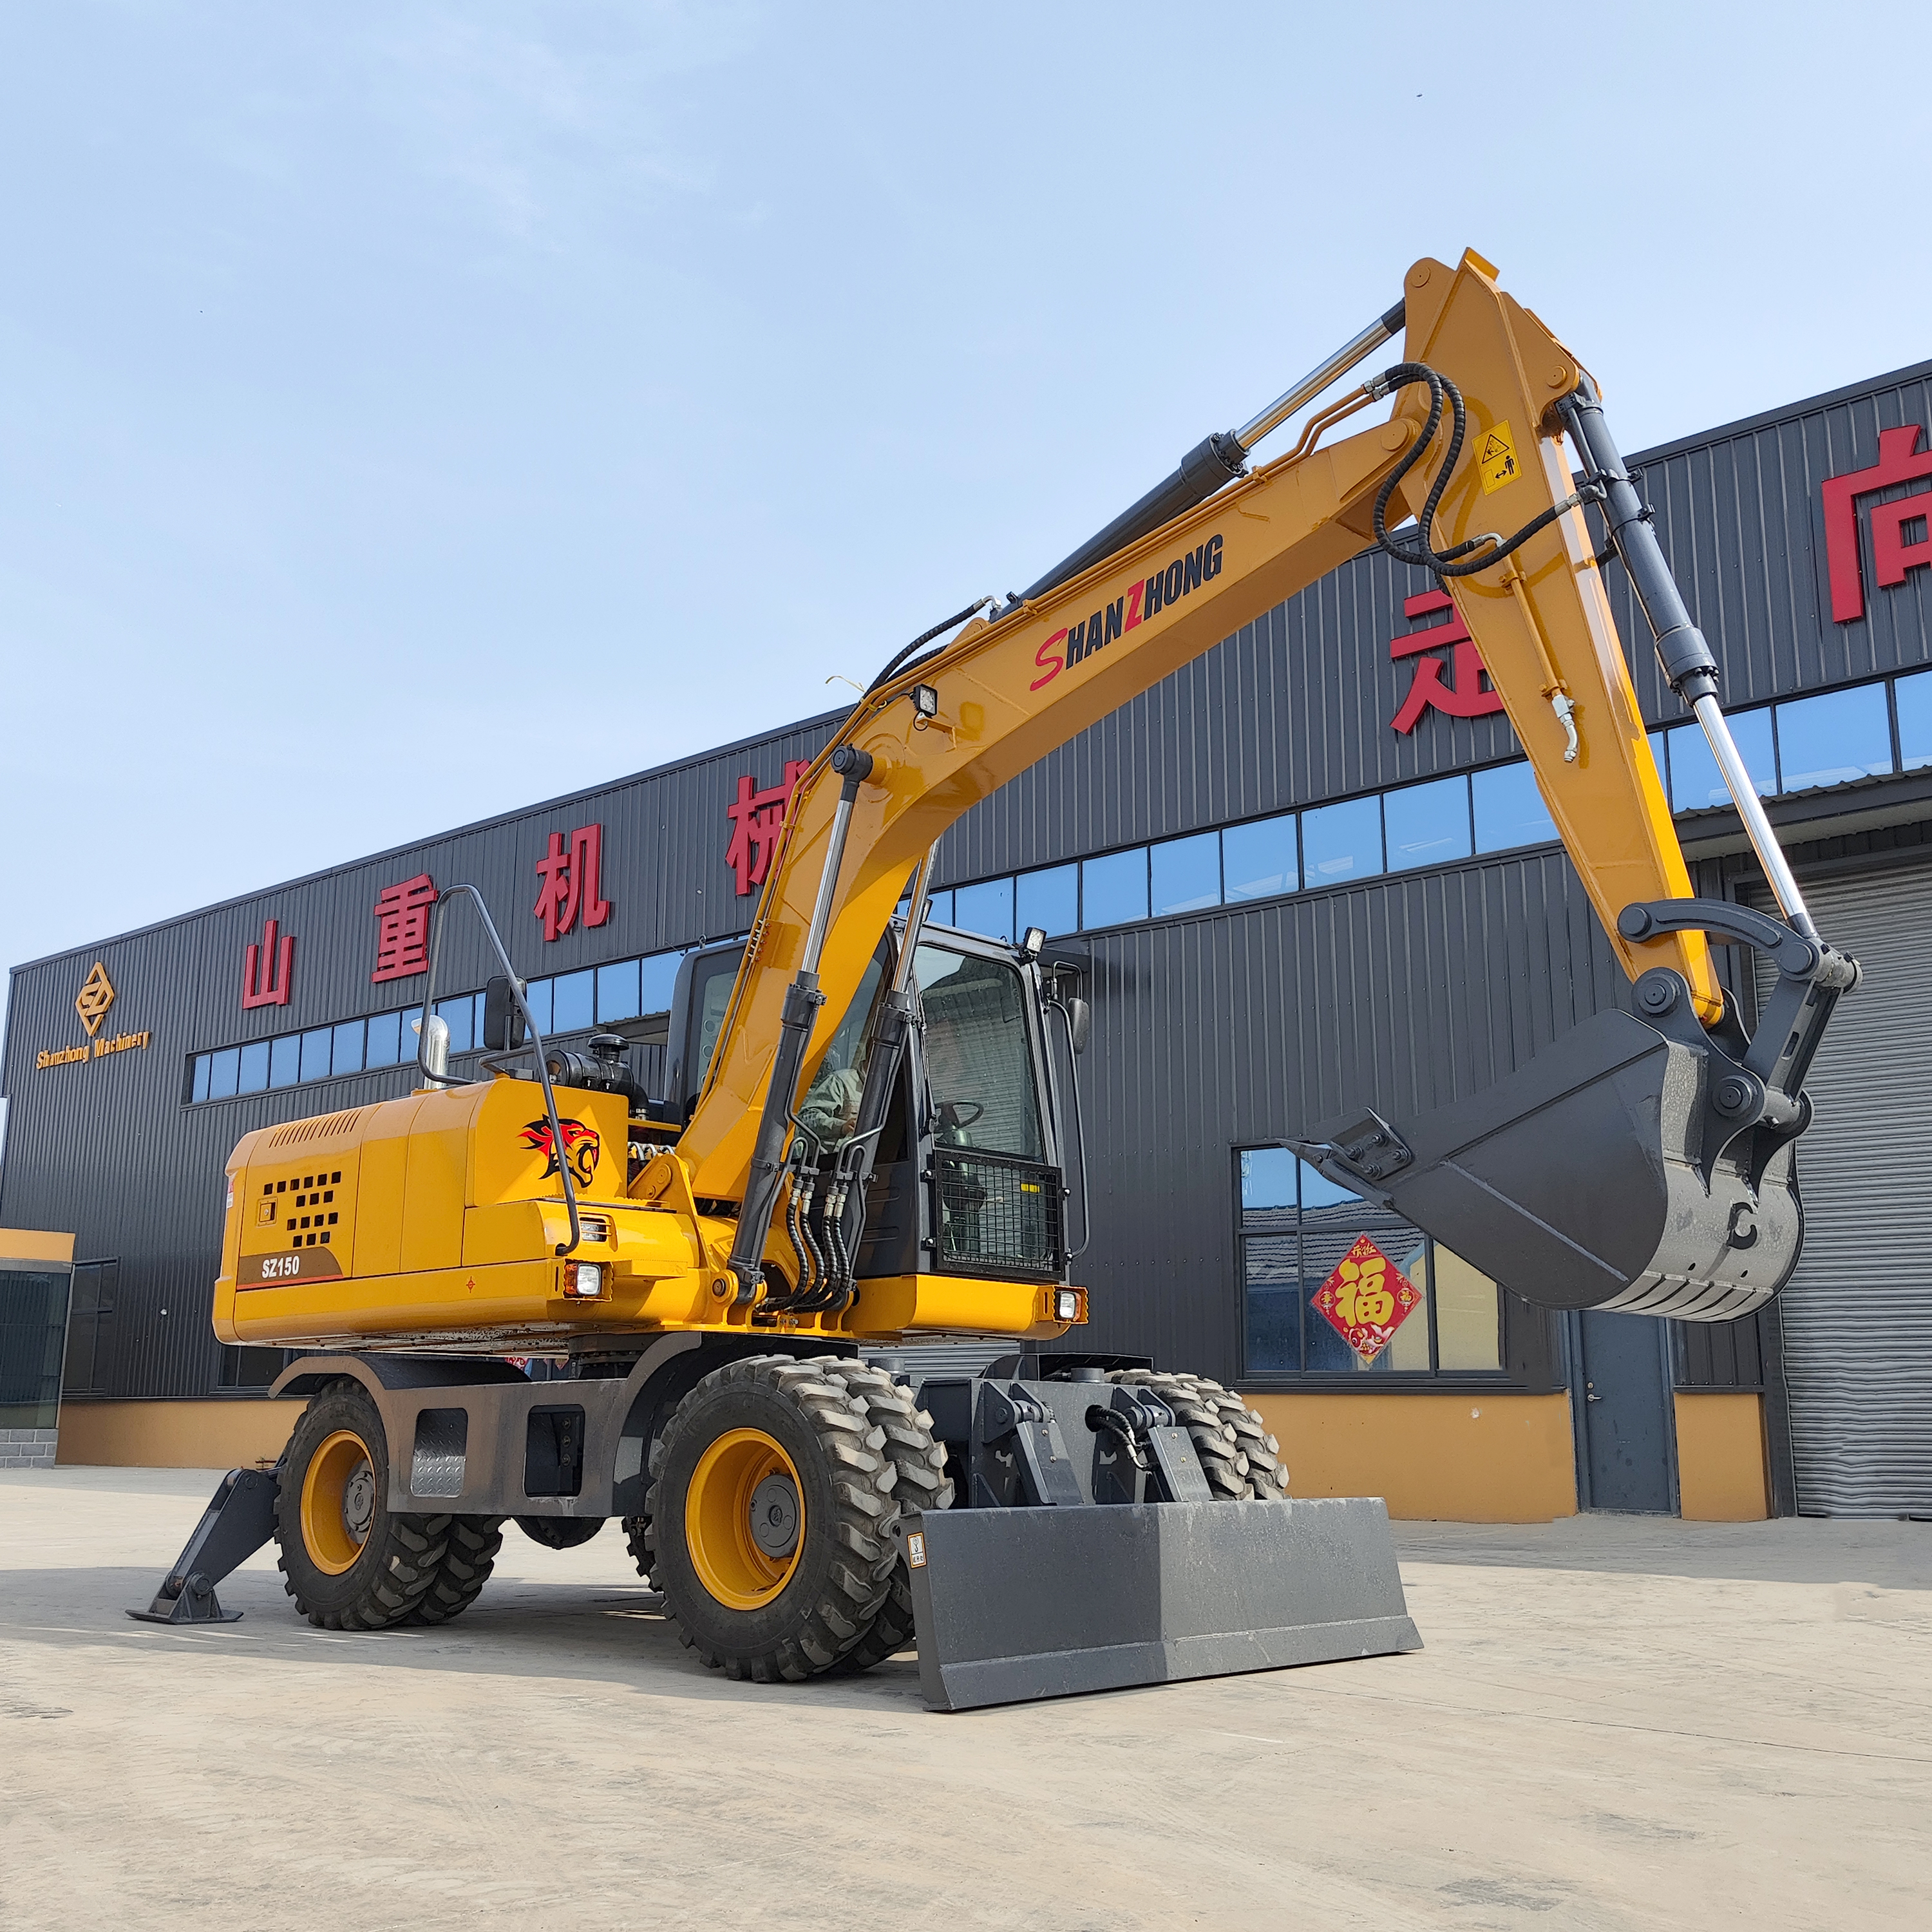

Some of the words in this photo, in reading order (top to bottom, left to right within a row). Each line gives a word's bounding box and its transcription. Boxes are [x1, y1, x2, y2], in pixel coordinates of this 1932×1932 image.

[1029, 533, 1224, 692] SHANZHONG
[36, 1045, 90, 1069] Shanzhong
[94, 1031, 149, 1058] Machinery
[261, 1255, 300, 1278] SZ150
[1334, 1256, 1395, 1328] 福
